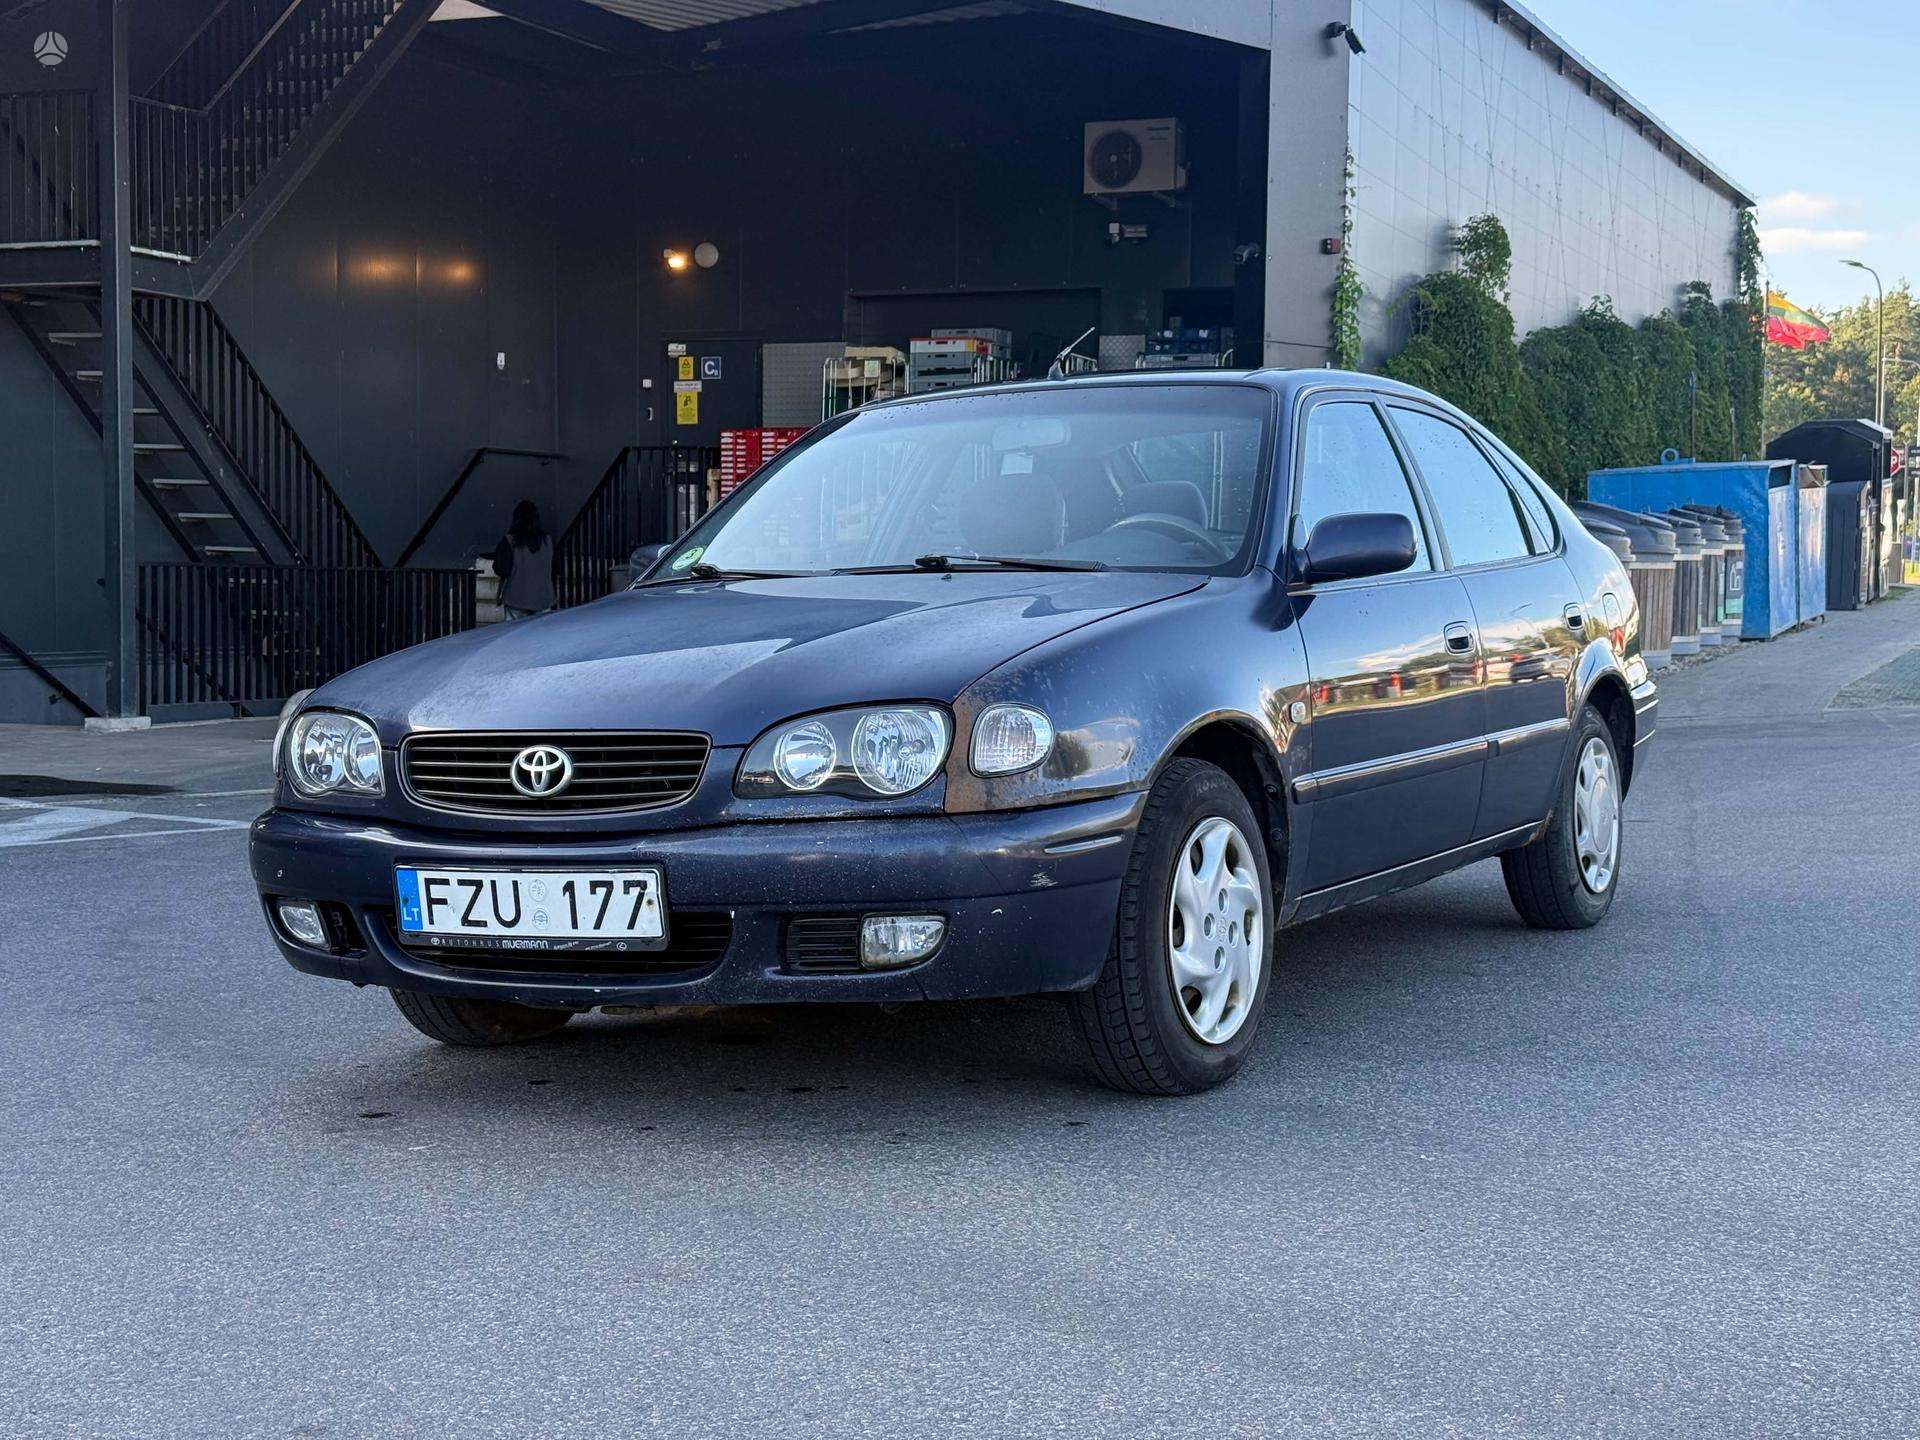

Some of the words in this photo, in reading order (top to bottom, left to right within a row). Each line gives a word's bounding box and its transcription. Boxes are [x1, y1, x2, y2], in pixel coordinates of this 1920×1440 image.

[402, 907, 419, 921] LT
[424, 877, 522, 929] FZU
[562, 880, 648, 930] 177
